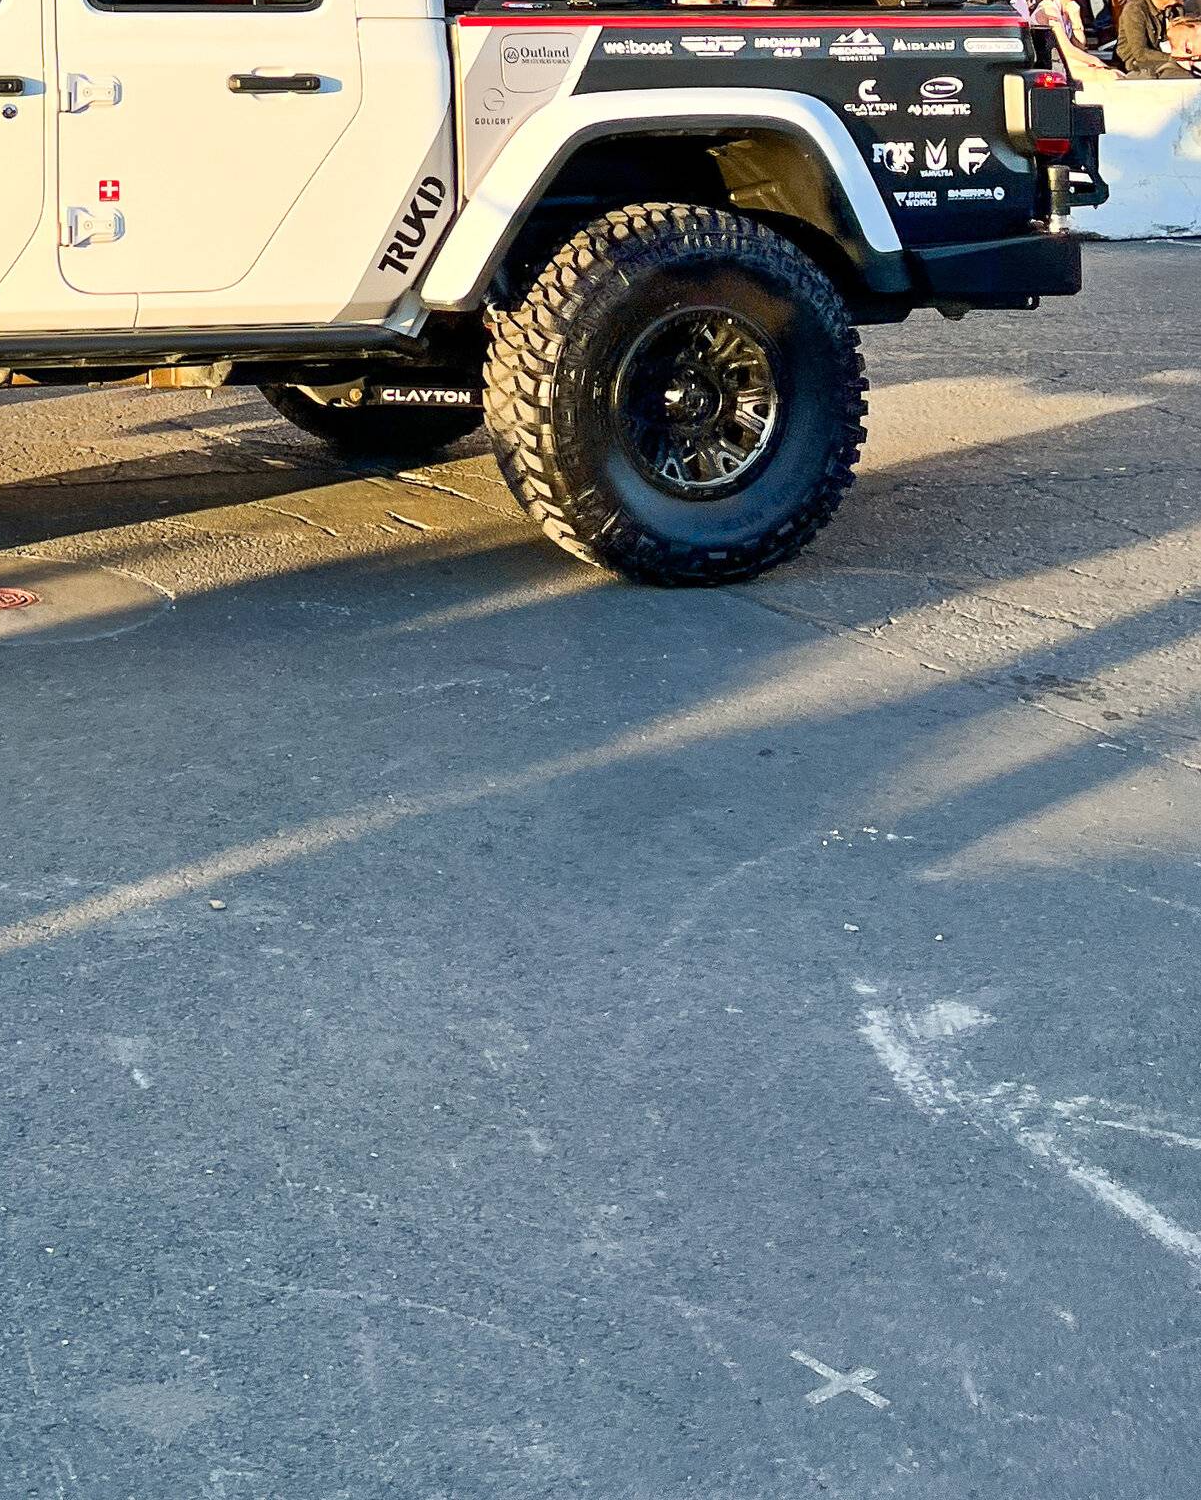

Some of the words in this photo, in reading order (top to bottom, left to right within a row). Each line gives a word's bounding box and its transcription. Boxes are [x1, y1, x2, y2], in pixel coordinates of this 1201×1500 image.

[754, 37, 821, 48] IRONMAN
[520, 46, 570, 58] Outland
[843, 102, 898, 114] CLAYTON
[922, 103, 972, 116] DOMETIC
[377, 176, 446, 275] TRUKD
[382, 389, 471, 404] CLAYTON
